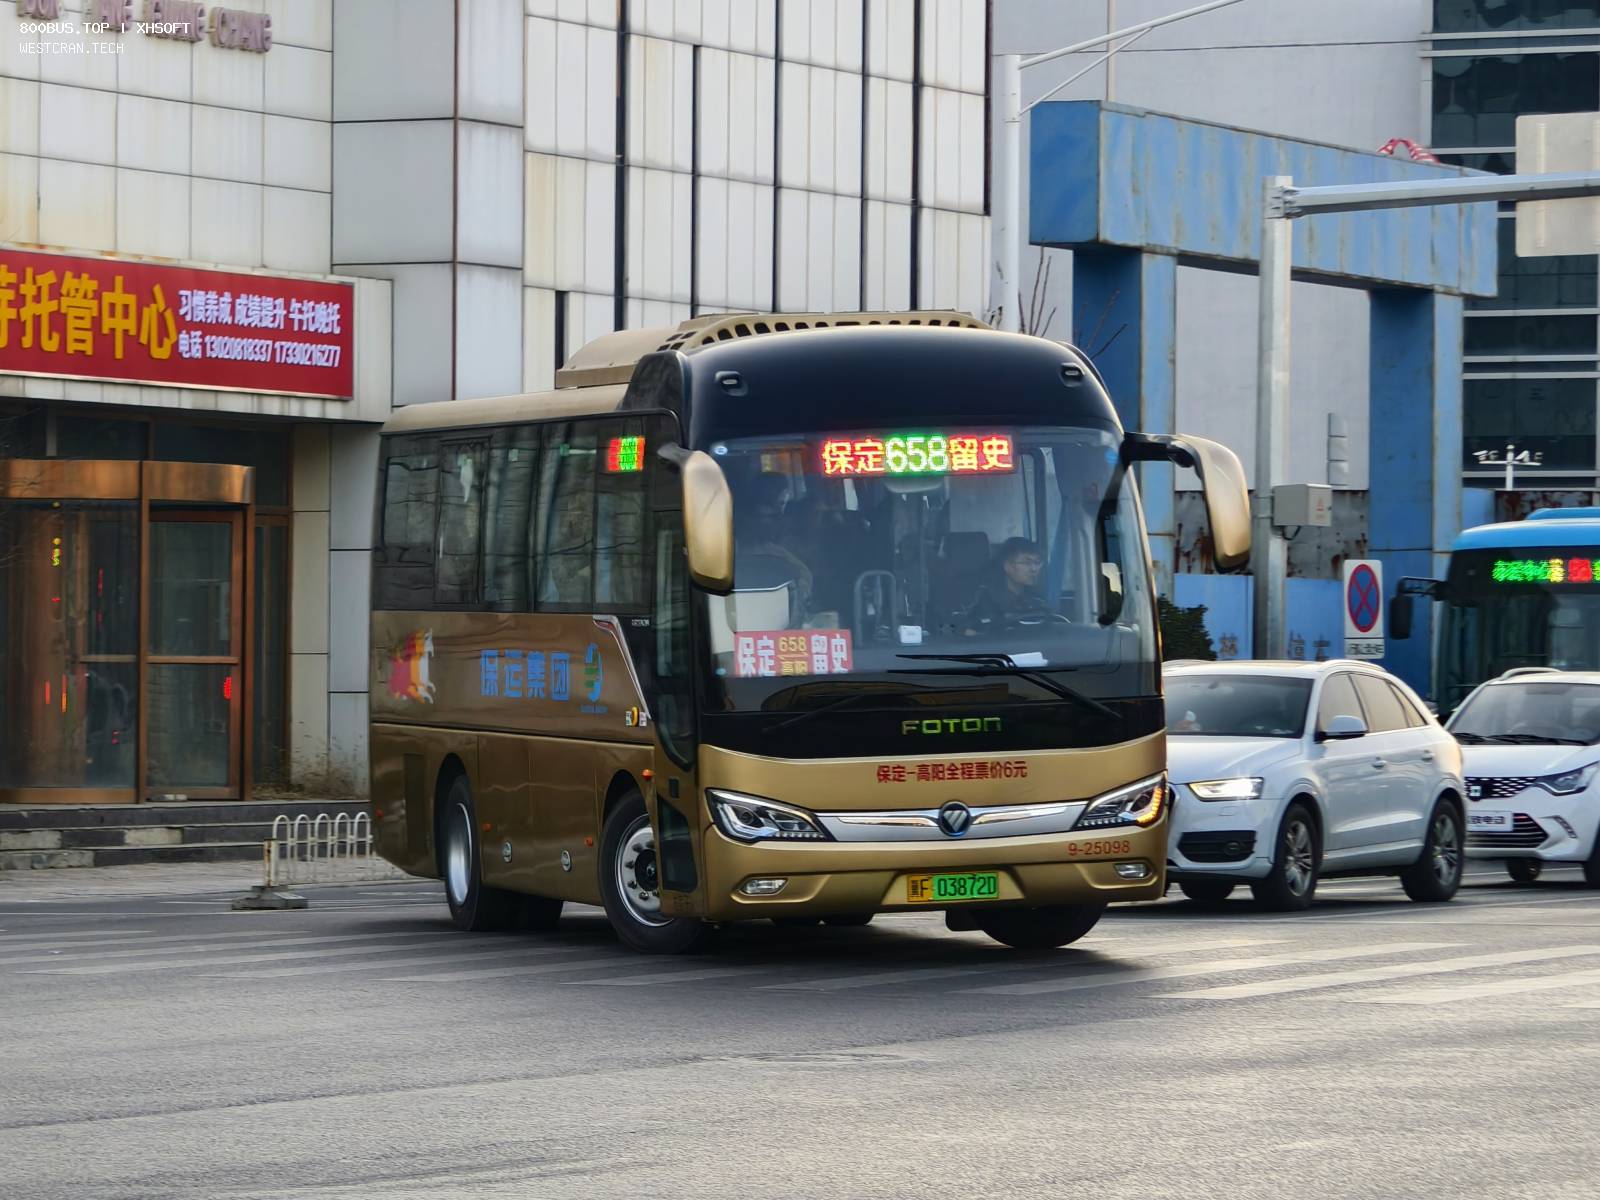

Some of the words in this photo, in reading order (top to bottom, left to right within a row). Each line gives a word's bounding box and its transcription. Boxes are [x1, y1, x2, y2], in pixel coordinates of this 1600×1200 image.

[178, 289, 232, 325] 习惯养成
[178, 330, 202, 359] 电话
[821, 436, 1013, 474] 保定658留史
[738, 635, 776, 677] 保定
[779, 636, 806, 651] 658
[811, 634, 848, 675] 留史
[902, 717, 1002, 735] FOTON
[1068, 841, 1130, 856] 9-25098
[937, 876, 997, 897] 03872D
